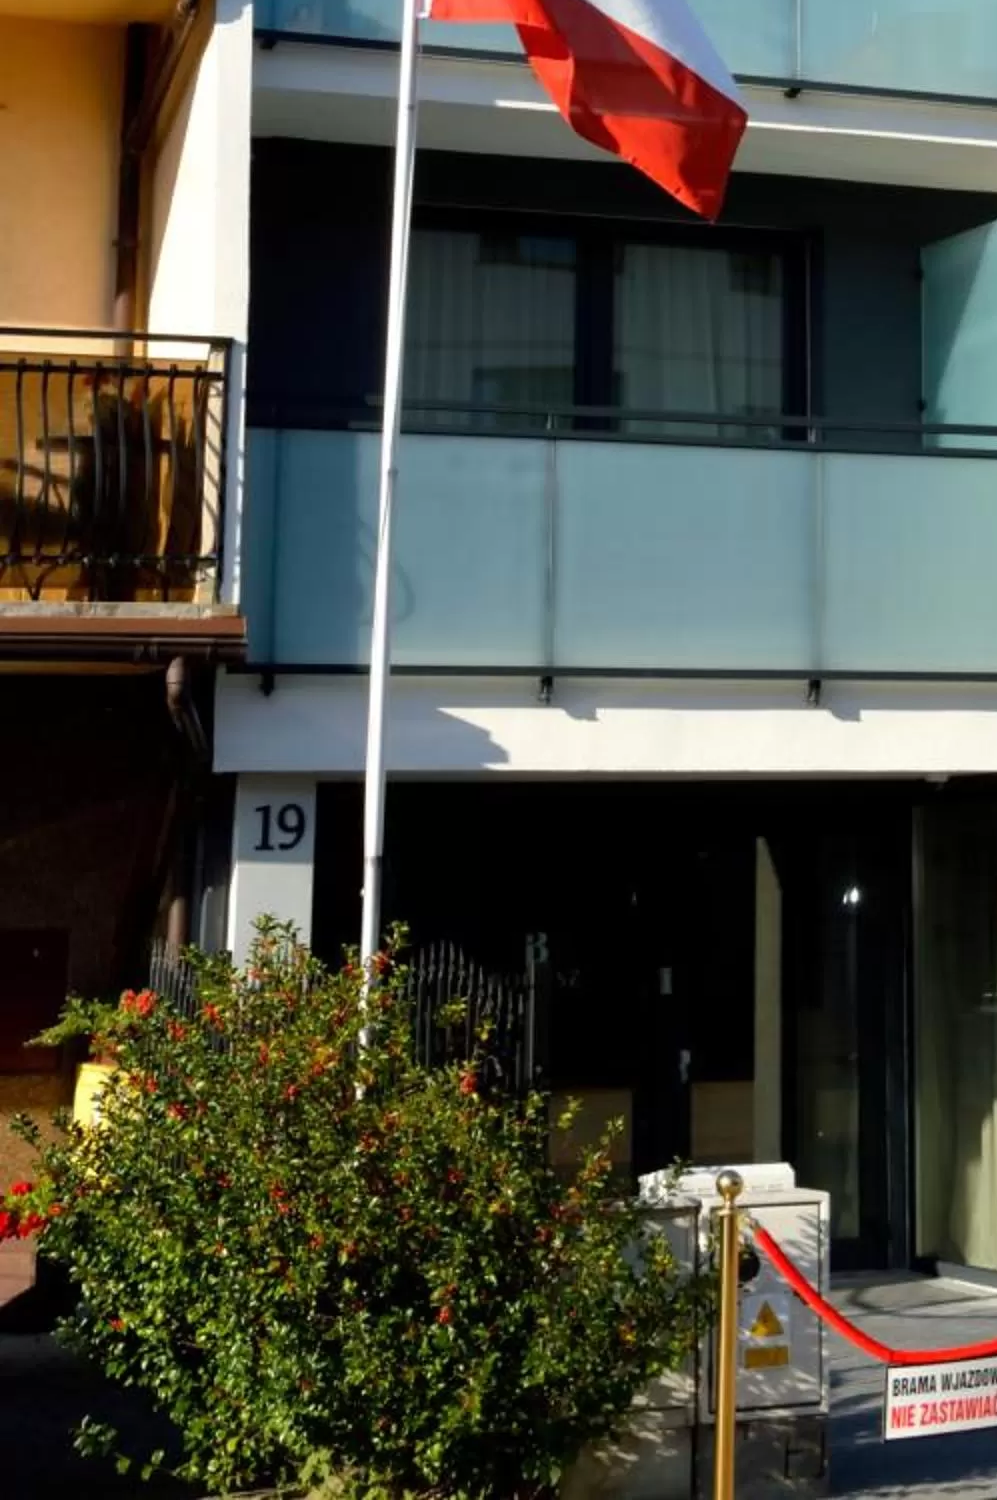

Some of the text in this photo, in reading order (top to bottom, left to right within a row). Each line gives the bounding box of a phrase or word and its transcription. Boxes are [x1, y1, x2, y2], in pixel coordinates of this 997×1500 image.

[253, 803, 306, 851] 19
[892, 1374, 937, 1397] BRAMA
[891, 1404, 915, 1428] NIE
